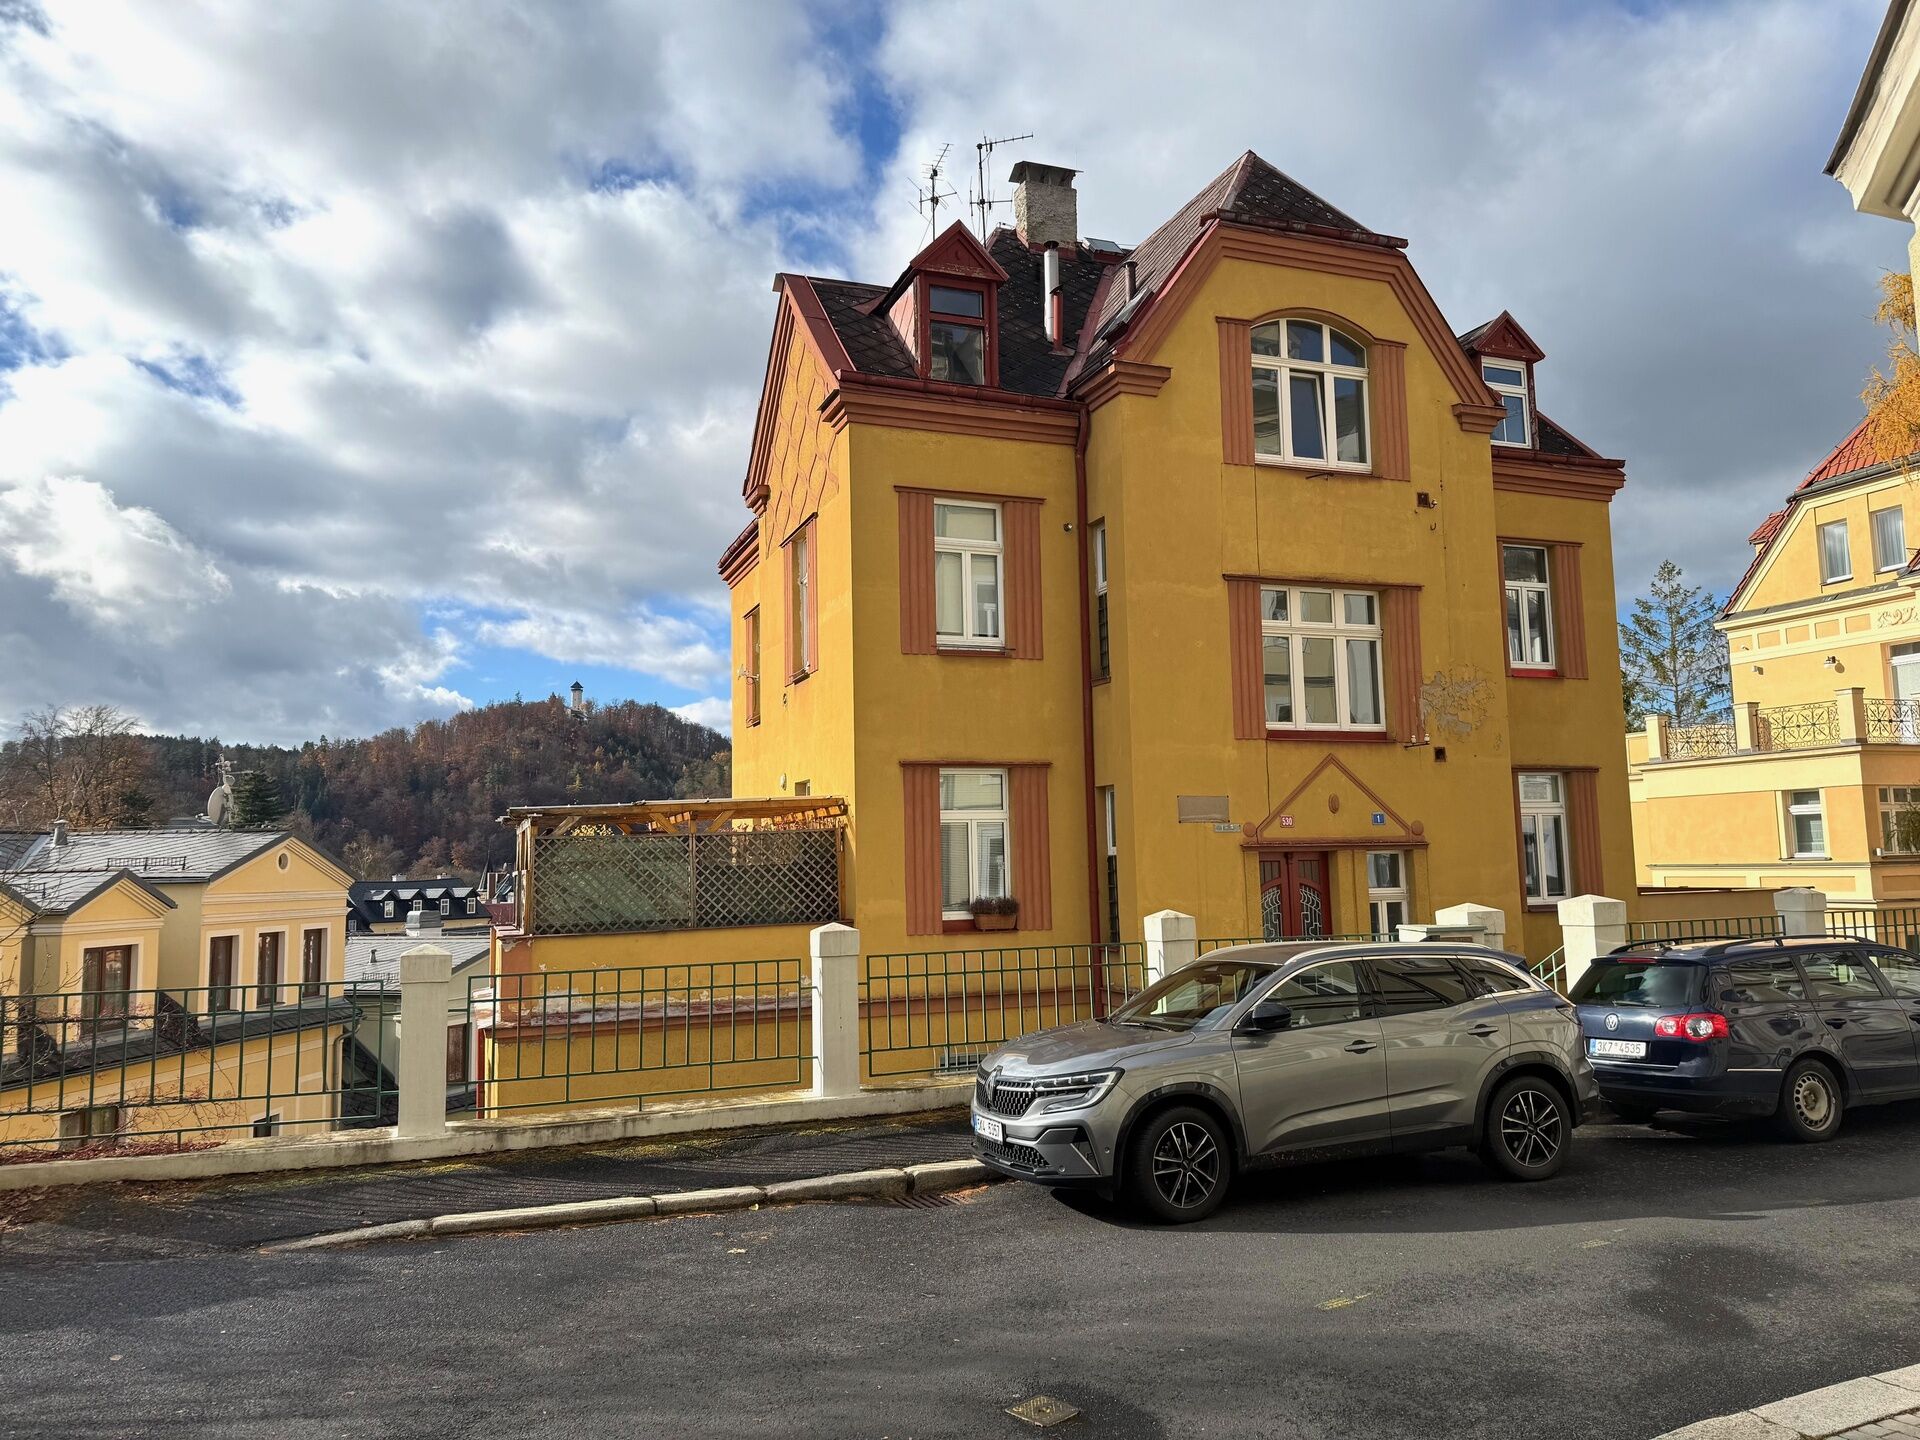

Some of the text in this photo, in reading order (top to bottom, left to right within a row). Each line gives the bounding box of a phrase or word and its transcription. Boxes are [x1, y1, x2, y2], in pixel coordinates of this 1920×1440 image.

[1282, 817, 1293, 826] 530
[1597, 1041, 1641, 1054] 3K7 4535
